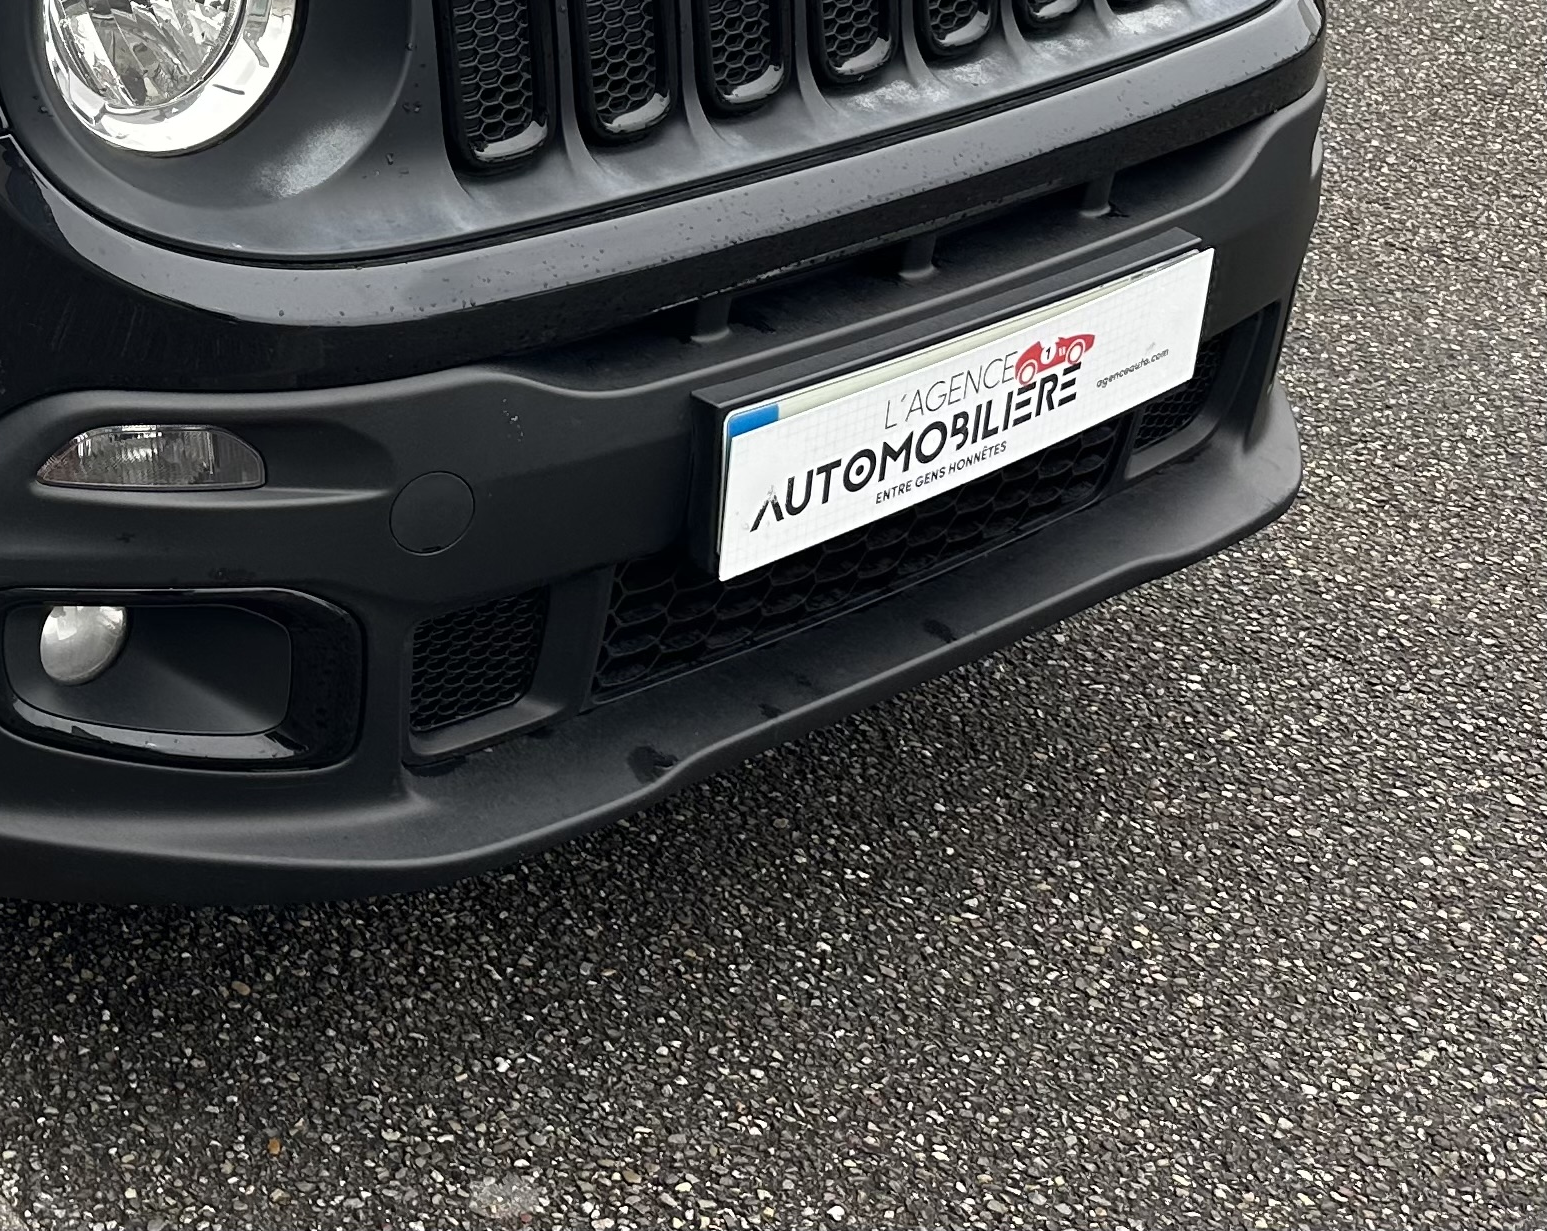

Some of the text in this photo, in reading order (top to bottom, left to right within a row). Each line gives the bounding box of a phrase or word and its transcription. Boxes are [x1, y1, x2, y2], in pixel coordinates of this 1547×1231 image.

[885, 351, 1018, 429] L'AGENCE
[1096, 348, 1169, 388] agenceauto.com
[876, 440, 1007, 504] ENTRE GENS HONNÊTES
